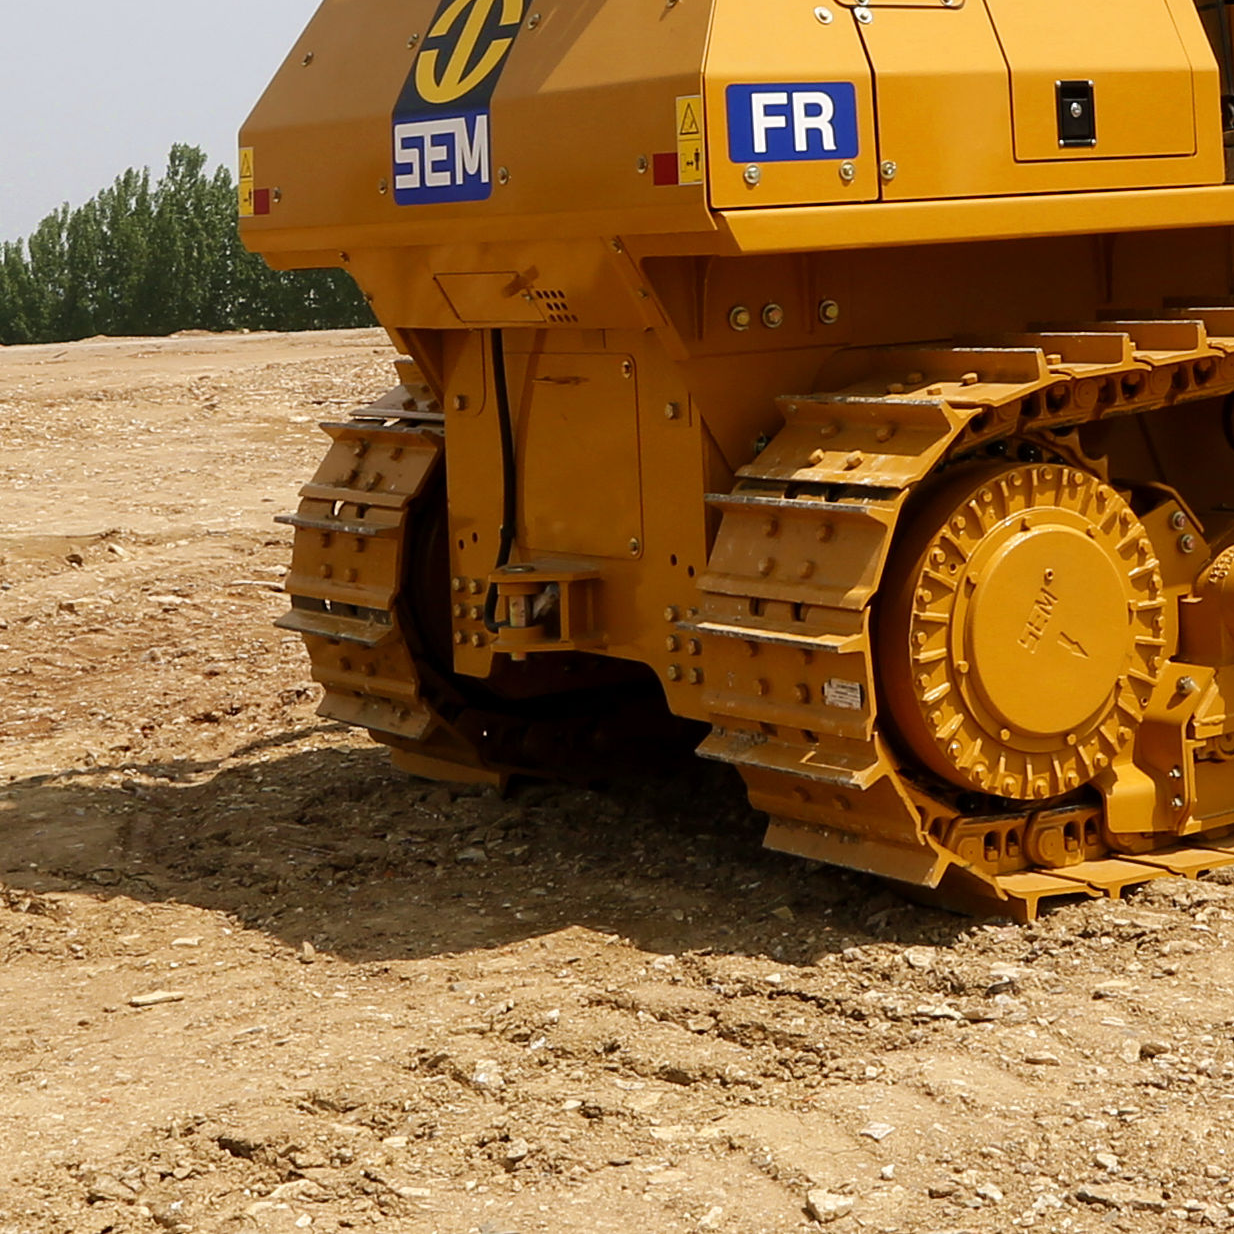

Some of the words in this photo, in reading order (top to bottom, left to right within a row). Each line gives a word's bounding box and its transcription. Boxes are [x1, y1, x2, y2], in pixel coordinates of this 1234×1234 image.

[394, 114, 489, 189] SEM
[751, 91, 837, 153] FR
[1017, 587, 1058, 654] SEM
